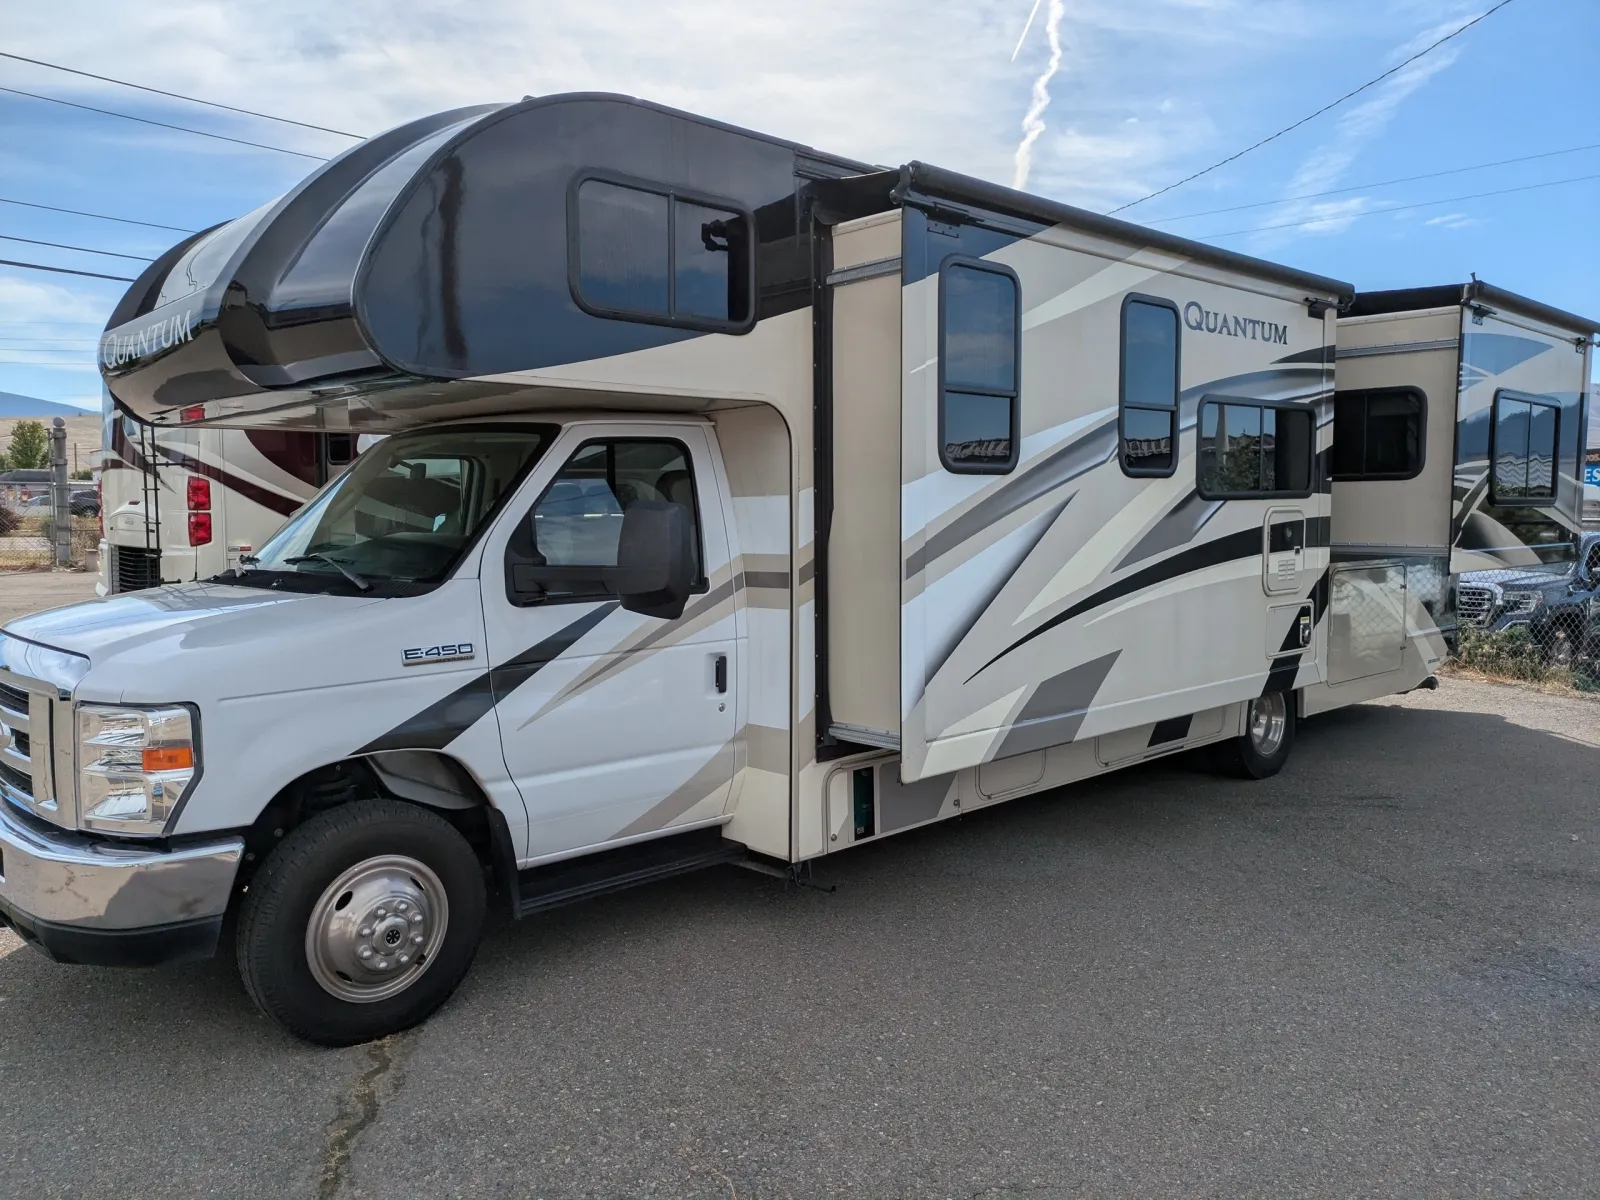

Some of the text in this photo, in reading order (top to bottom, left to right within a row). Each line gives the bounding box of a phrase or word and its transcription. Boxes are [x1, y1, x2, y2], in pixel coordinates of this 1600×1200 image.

[104, 309, 194, 369] QUANTUM
[1184, 301, 1288, 345] QUANTUM
[403, 643, 473, 660] E-450
